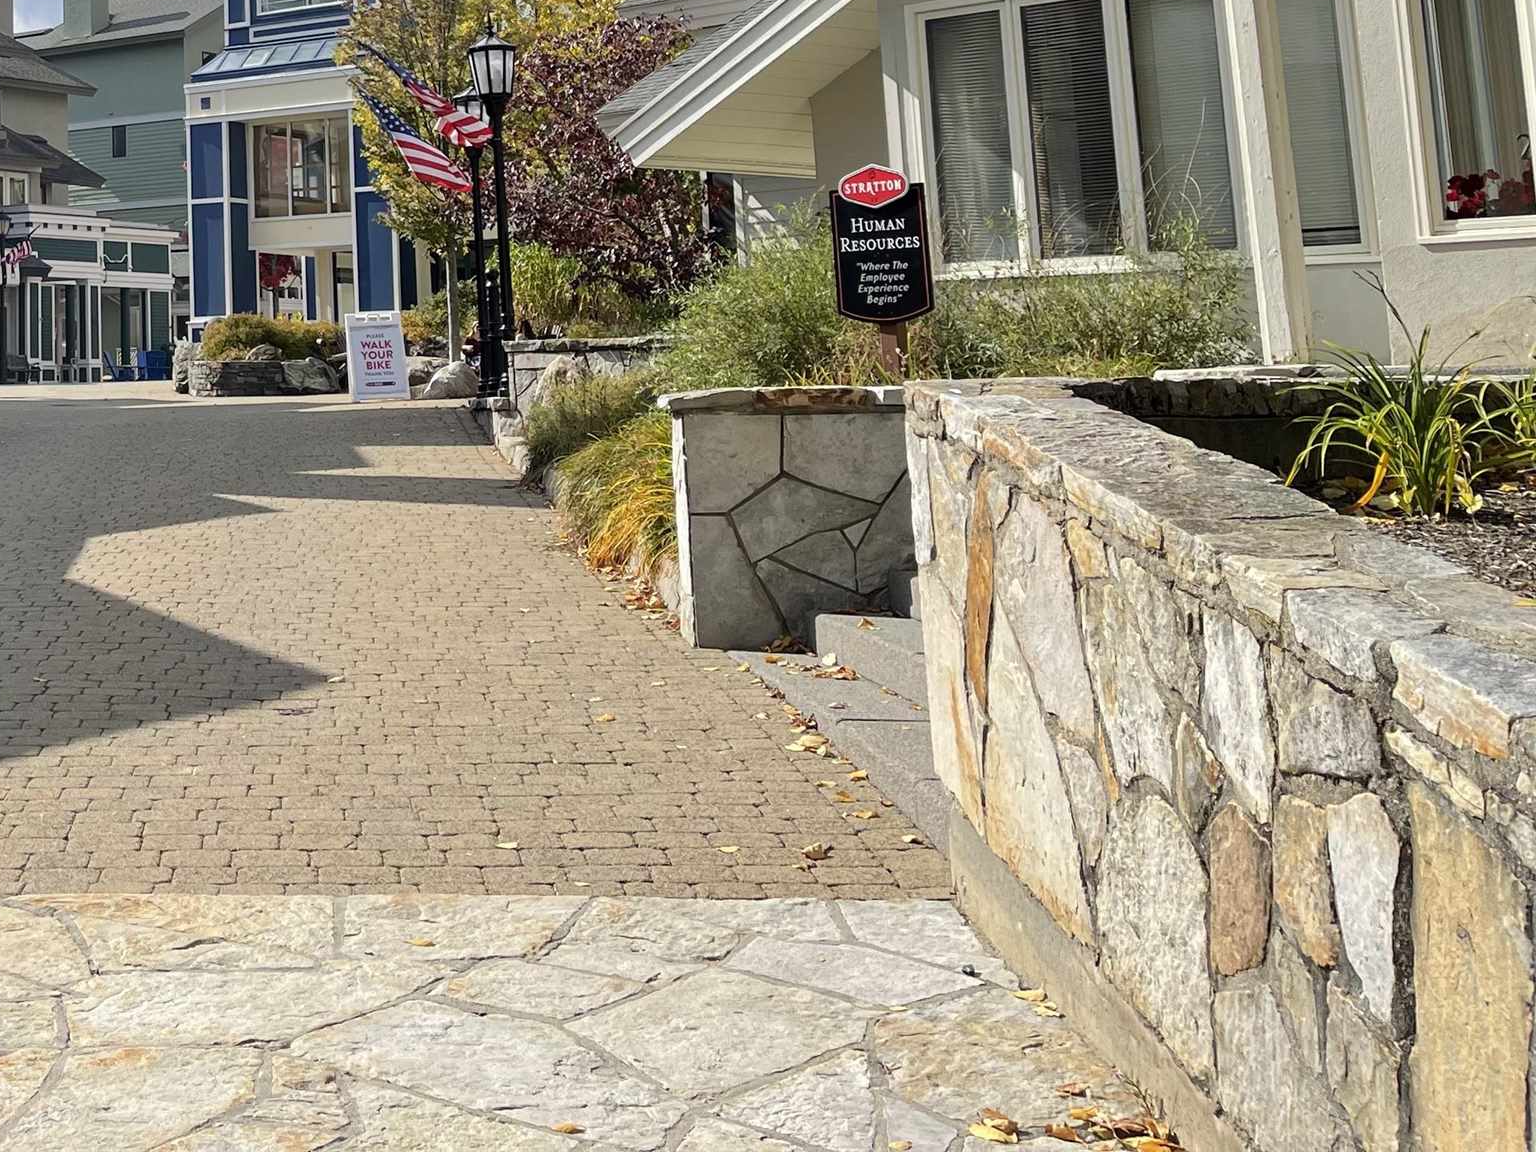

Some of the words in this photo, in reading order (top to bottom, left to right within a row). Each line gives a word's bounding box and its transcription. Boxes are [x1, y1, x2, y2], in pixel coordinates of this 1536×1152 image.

[844, 179, 902, 195] STRATTON
[850, 218, 905, 233] HUMAN
[840, 236, 920, 252] RESOURCES
[892, 260, 908, 270] The
[860, 273, 905, 285] Employee
[858, 284, 909, 294] Experience
[360, 340, 392, 349] WALK
[361, 350, 393, 360] YOUR
[366, 361, 391, 370] BIKE
